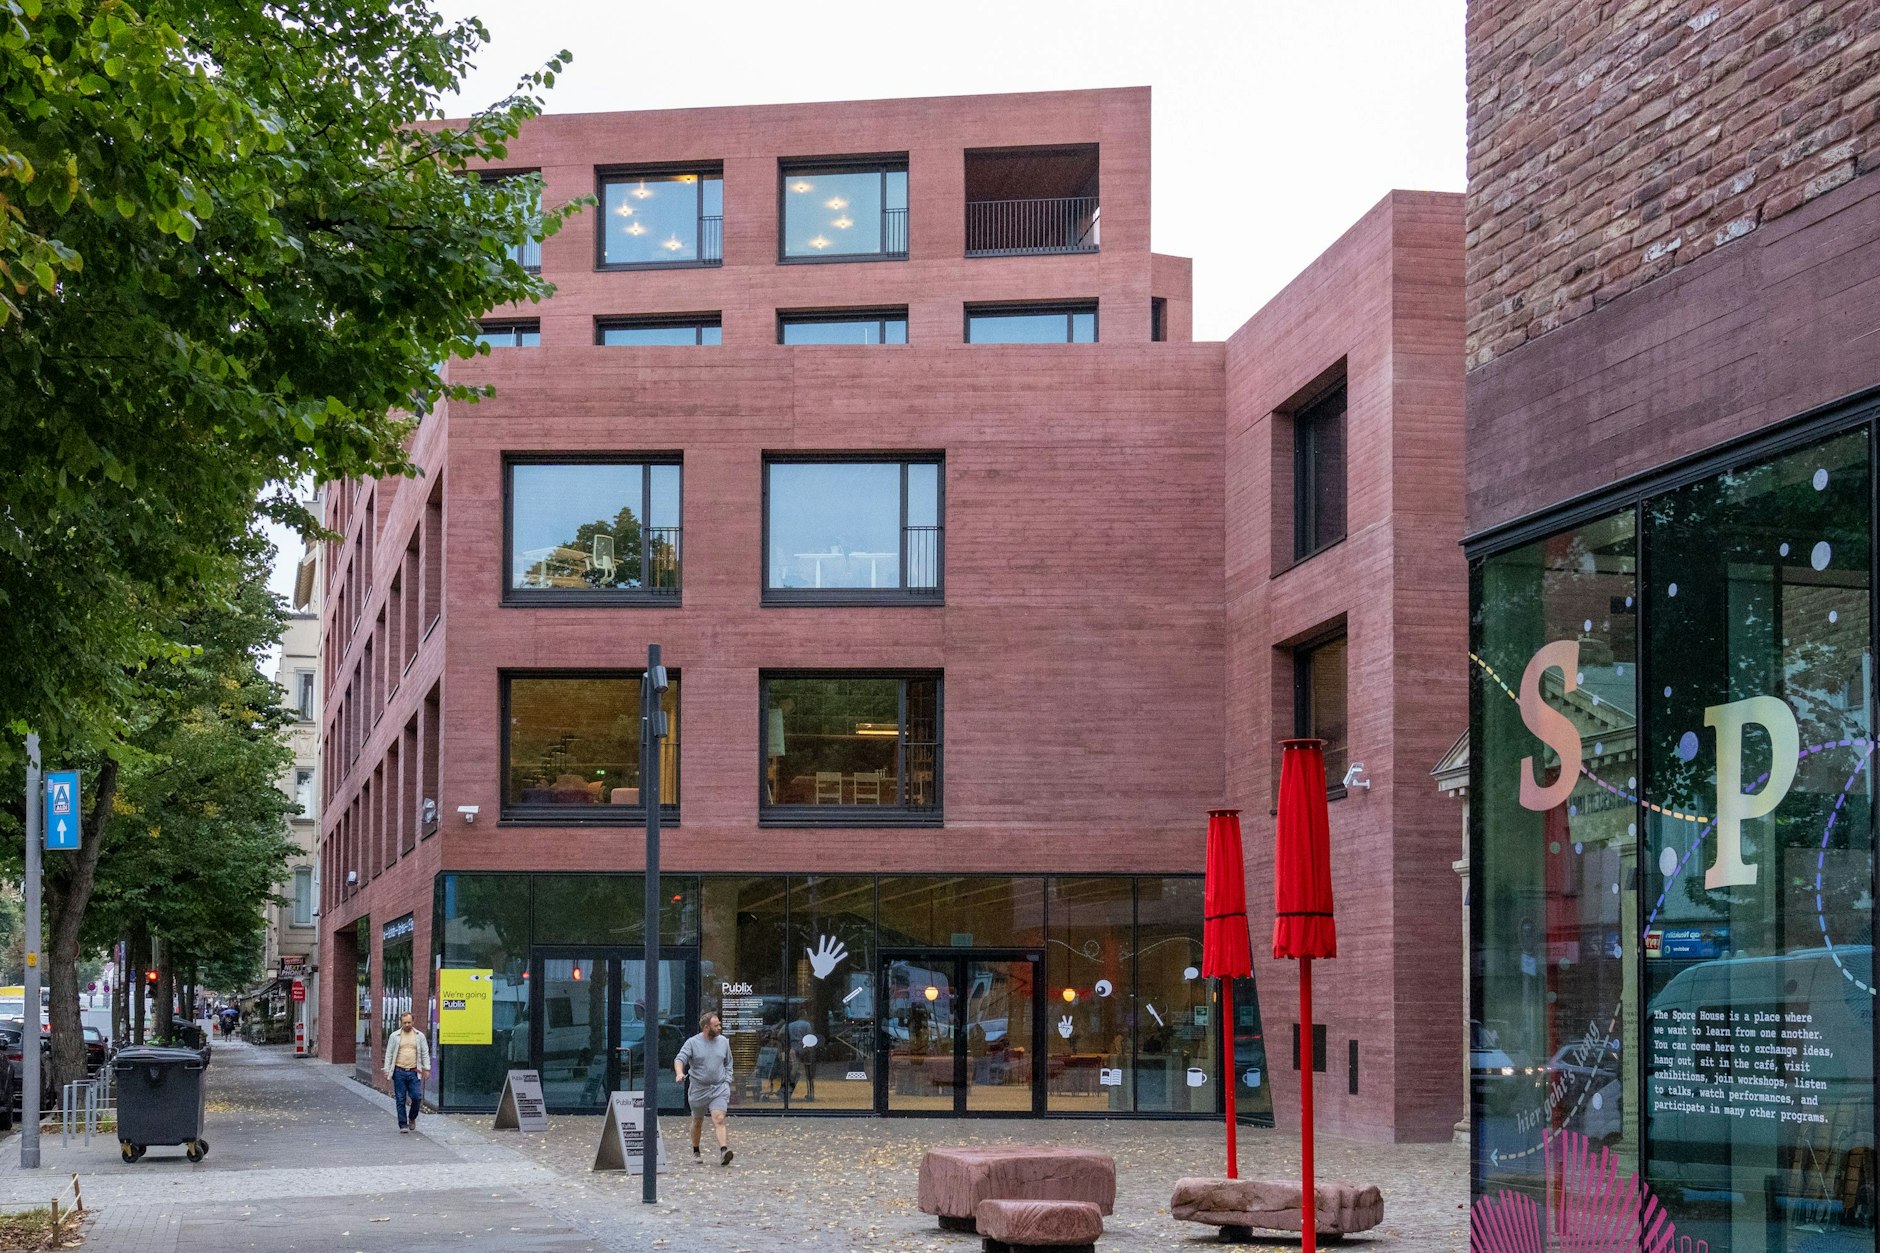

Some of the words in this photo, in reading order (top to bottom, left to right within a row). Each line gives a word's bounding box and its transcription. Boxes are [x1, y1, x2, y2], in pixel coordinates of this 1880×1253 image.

[1519, 639, 1582, 812] S
[1703, 695, 1799, 890] P
[466, 992, 487, 1000] going
[722, 982, 752, 993] Publix
[443, 1000, 466, 1008] Publix
[1654, 1011, 1668, 1019] The
[1672, 1011, 1695, 1022] Spore
[1700, 1011, 1724, 1020] House
[1729, 1011, 1739, 1020] is
[1754, 1012, 1780, 1024] place
[1785, 1013, 1812, 1022] where
[1668, 1026, 1687, 1034] want
[1706, 1026, 1730, 1036] learn
[1735, 1028, 1756, 1037] from
[1781, 1029, 1822, 1039] another.
[1654, 1040, 1668, 1049] You
[1715, 1042, 1735, 1052] here
[1740, 1044, 1750, 1053] to
[1755, 1045, 1797, 1059] exchange
[1803, 1046, 1833, 1058] ideas,
[1654, 1055, 1673, 1066] hang
[1678, 1058, 1694, 1066] out,
[1700, 1057, 1714, 1066] sit
[1719, 1058, 1729, 1068] in
[1734, 1058, 1749, 1068] the
[1754, 1060, 1778, 1072] café,
[1784, 1061, 1810, 1072] visit
[1516, 1107, 1541, 1134] hier
[1543, 1069, 1575, 1122] geht's
[1573, 1020, 1600, 1067] lang
[1654, 1070, 1708, 1083] exhibitions,
[1714, 1072, 1733, 1085] join
[1738, 1075, 1788, 1088] workshops,
[1794, 1078, 1827, 1090] listen
[1655, 1085, 1663, 1094] to
[1668, 1085, 1694, 1097] talks,
[1700, 1088, 1724, 1098] watch
[1729, 1090, 1794, 1104] performances,
[1801, 1096, 1818, 1106] and
[1654, 1100, 1705, 1114] participate
[1710, 1104, 1720, 1113] in
[1724, 1107, 1745, 1118] many
[1750, 1107, 1776, 1118] other
[1781, 1111, 1828, 1123] programs.
